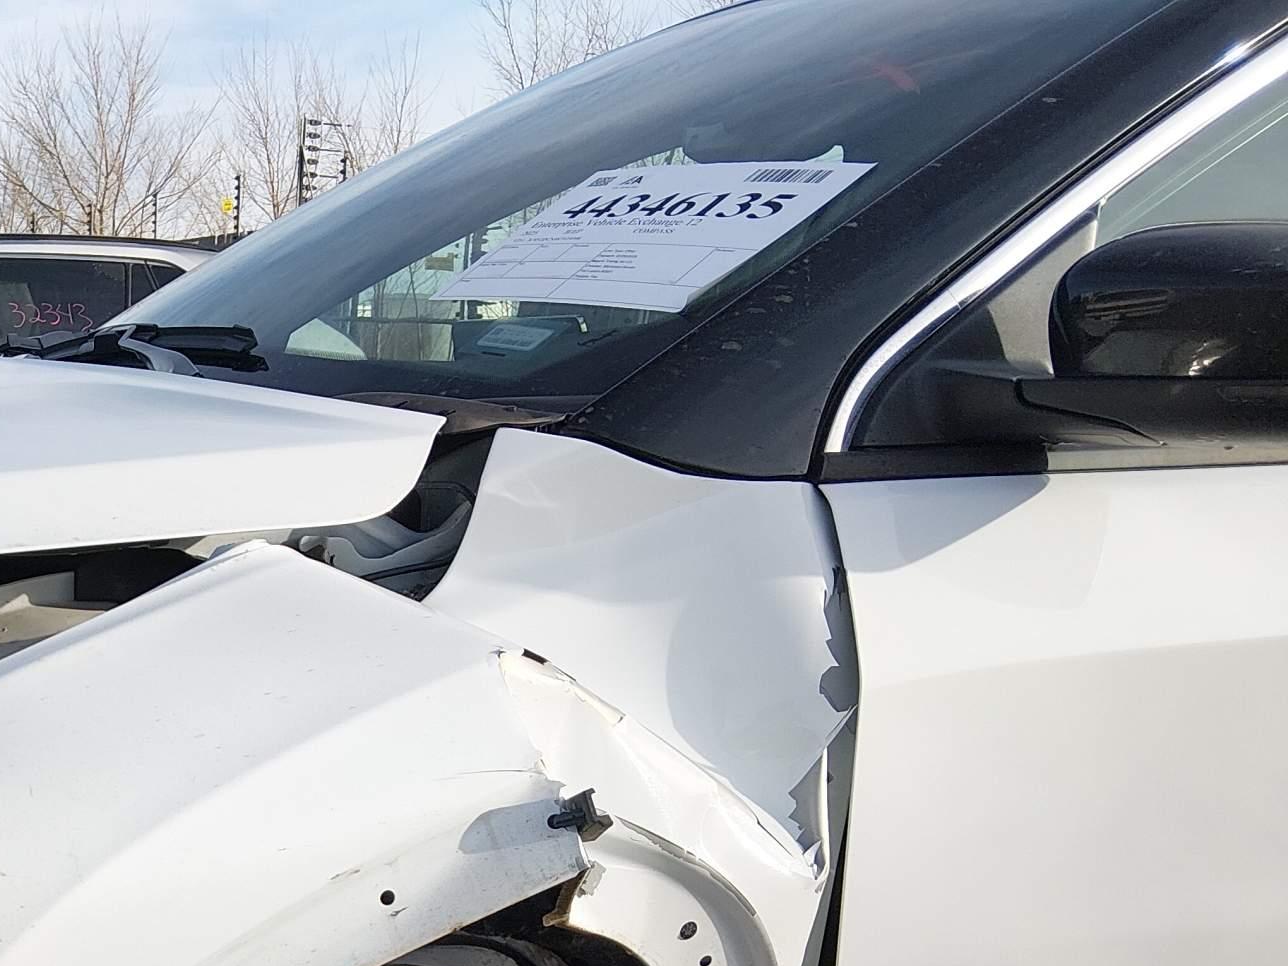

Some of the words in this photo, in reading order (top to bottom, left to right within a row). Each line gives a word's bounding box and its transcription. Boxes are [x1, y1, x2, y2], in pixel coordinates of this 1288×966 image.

[563, 192, 799, 219] 44346135
[531, 219, 584, 229] Enterprise
[586, 219, 626, 227] Vehicle
[627, 217, 684, 228] Exchange
